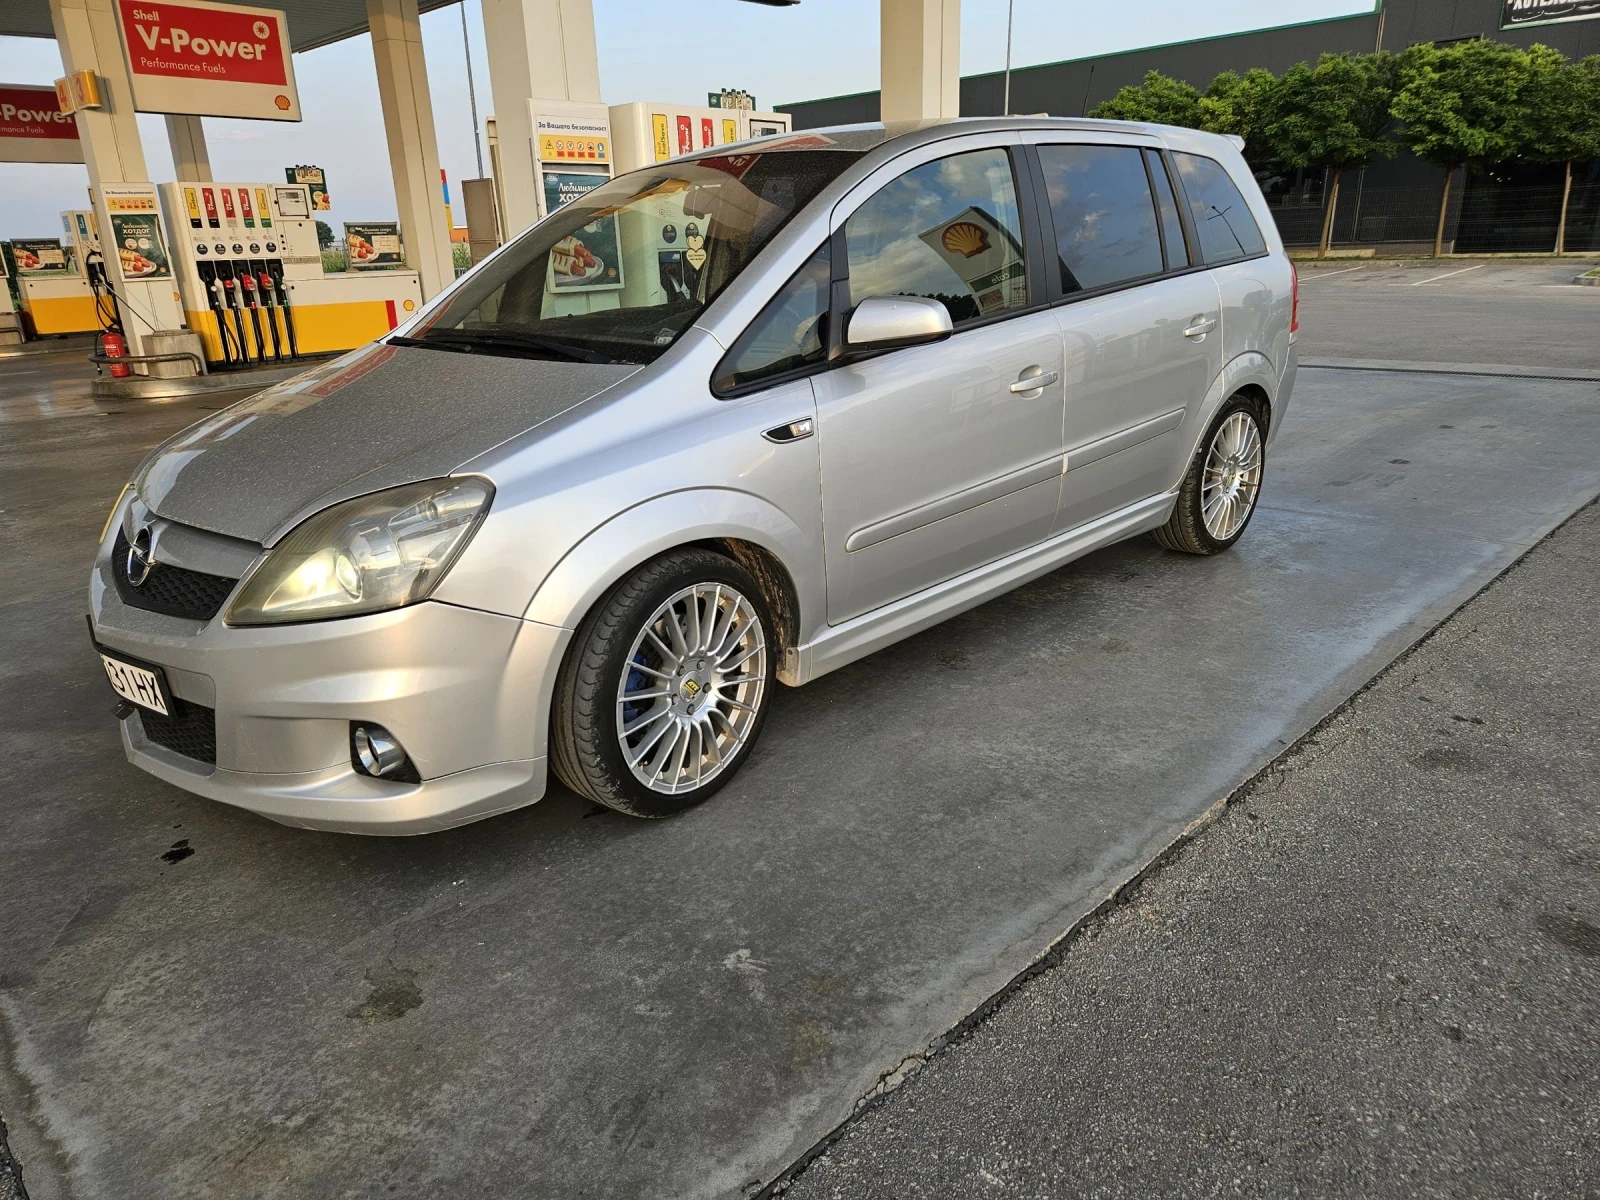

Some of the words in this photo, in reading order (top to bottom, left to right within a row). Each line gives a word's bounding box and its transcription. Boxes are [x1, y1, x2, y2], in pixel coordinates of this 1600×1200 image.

[133, 9, 160, 21] Shell
[134, 24, 267, 60] V-Power
[140, 57, 201, 71] Performance
[202, 62, 226, 74] Fuels
[26, 126, 45, 134] Fuels
[547, 122, 570, 130] Вашата
[571, 123, 607, 132] безопасност
